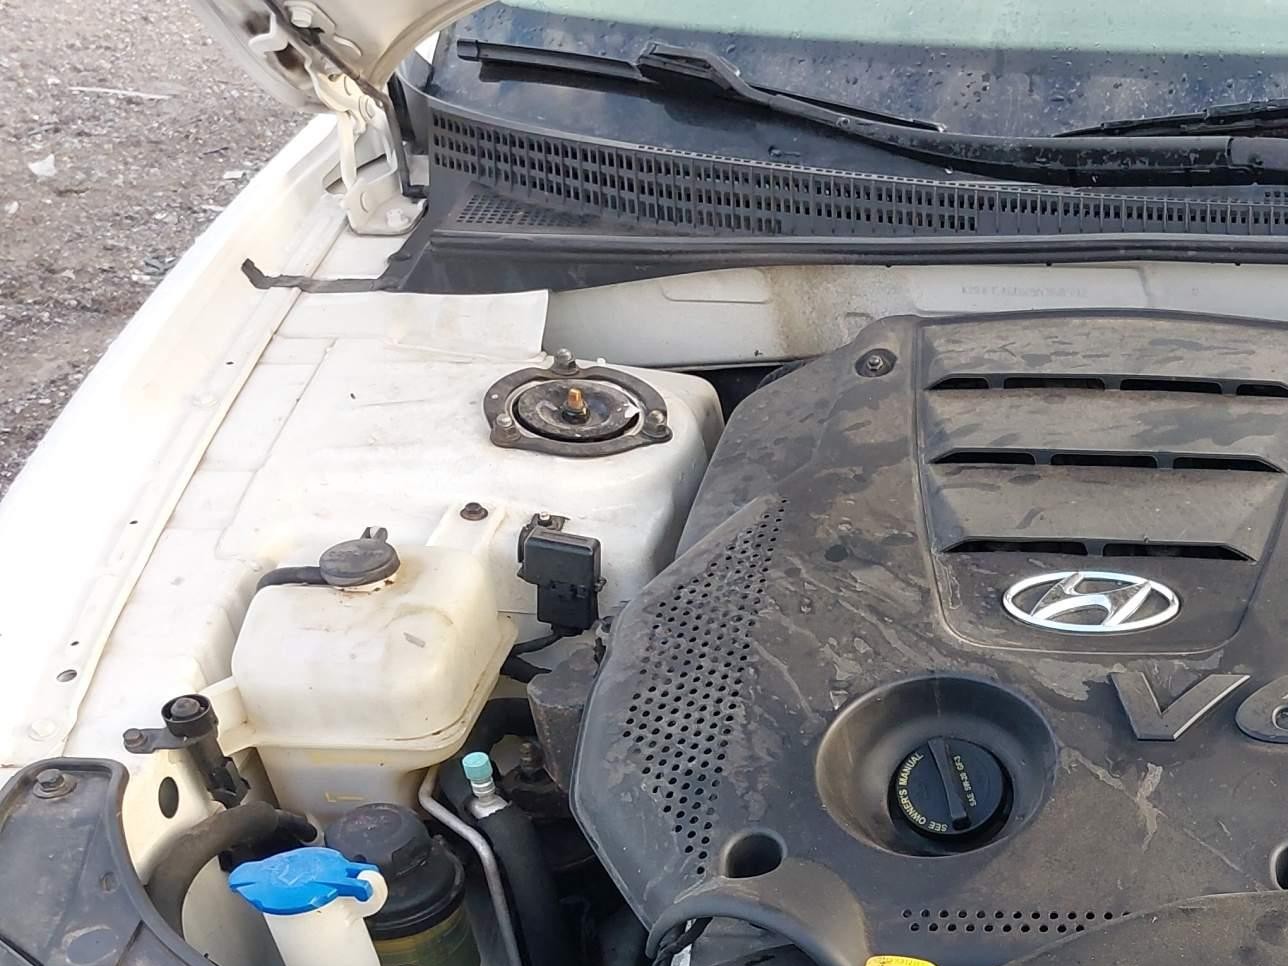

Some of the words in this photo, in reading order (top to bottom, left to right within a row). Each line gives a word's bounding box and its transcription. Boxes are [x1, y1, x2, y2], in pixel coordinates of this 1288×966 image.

[898, 751, 924, 786] MANUAL
[898, 788, 927, 825] OWNER'S
[928, 820, 949, 832] SEE
